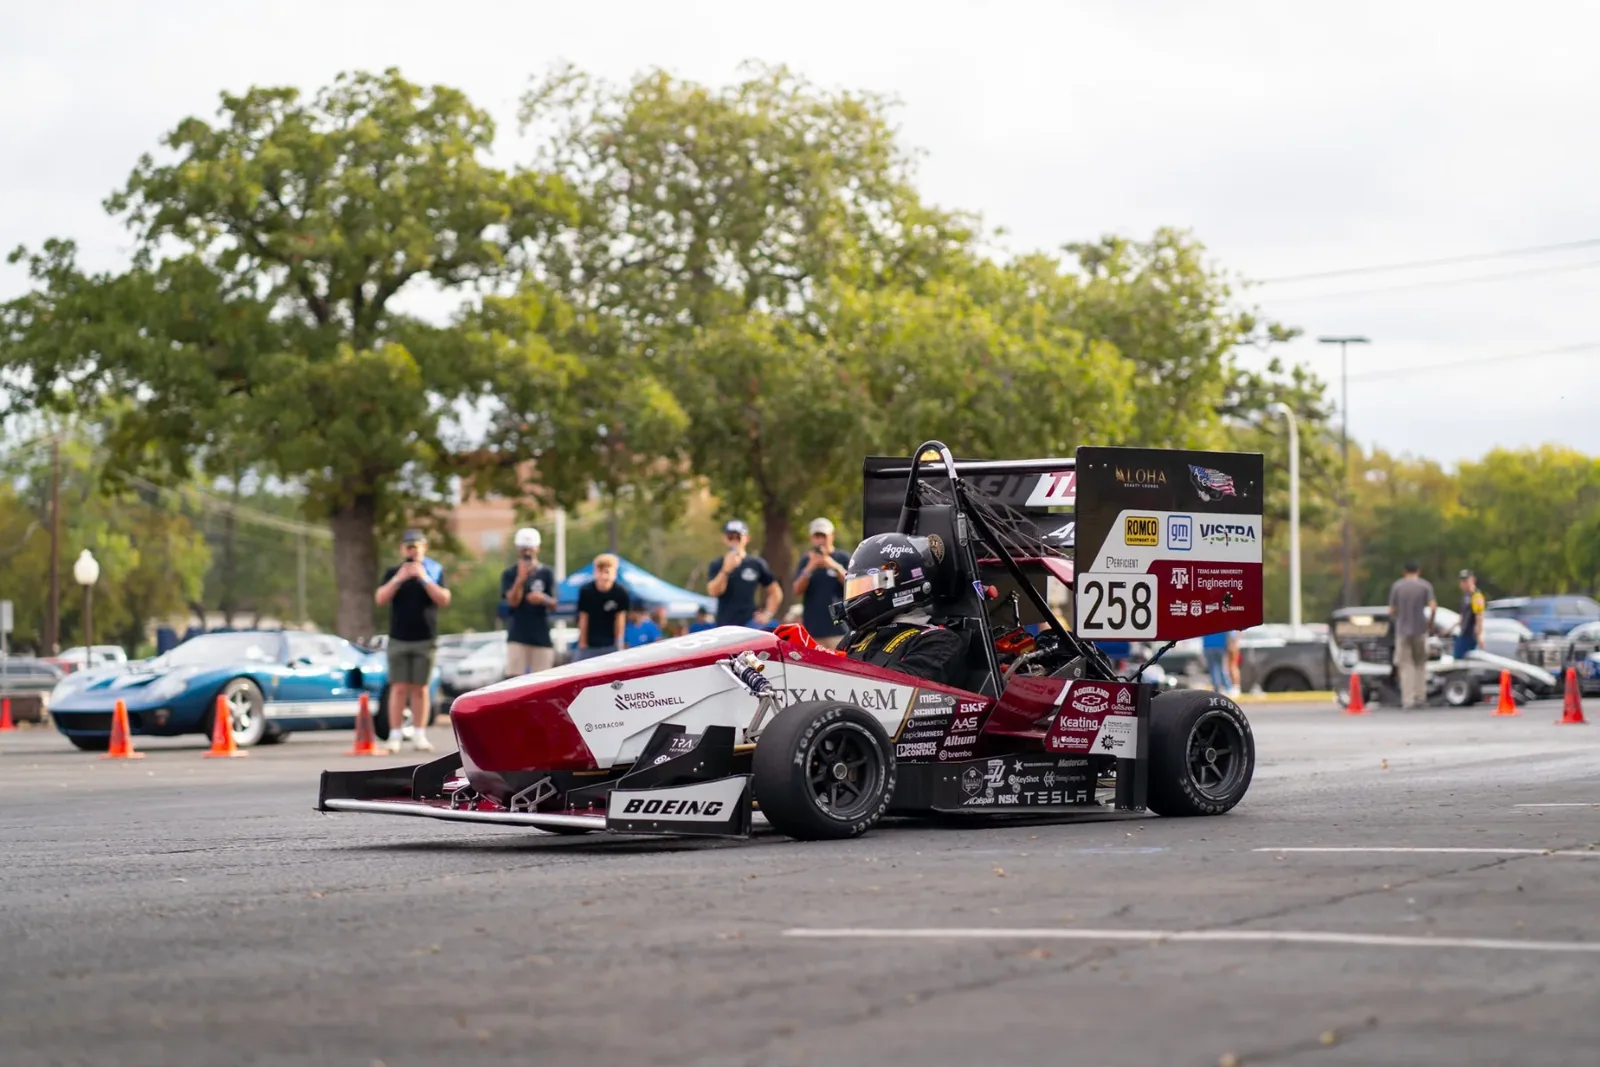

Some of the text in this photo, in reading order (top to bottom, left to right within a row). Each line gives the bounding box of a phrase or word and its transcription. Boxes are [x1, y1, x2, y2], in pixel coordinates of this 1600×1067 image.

[1127, 520, 1157, 536] ROMCO
[1171, 524, 1188, 542] gm
[880, 544, 915, 558] Aggies
[1197, 578, 1243, 591] Engineering
[1083, 580, 1152, 631] 258
[624, 691, 655, 702] BURNS
[1073, 686, 1110, 699] AGGIELAND
[960, 702, 988, 713] SKF
[1072, 700, 1109, 713] CHEVROLET
[594, 721, 625, 730] SORACOM
[951, 717, 978, 730] AAS
[1060, 716, 1098, 731] Keating
[943, 735, 977, 747] Altium
[906, 748, 937, 757] CONTACT
[1015, 775, 1040, 784] KeyShot
[998, 794, 1019, 804] NSK
[1023, 790, 1087, 804] TESLA
[623, 798, 724, 816] BOEING
